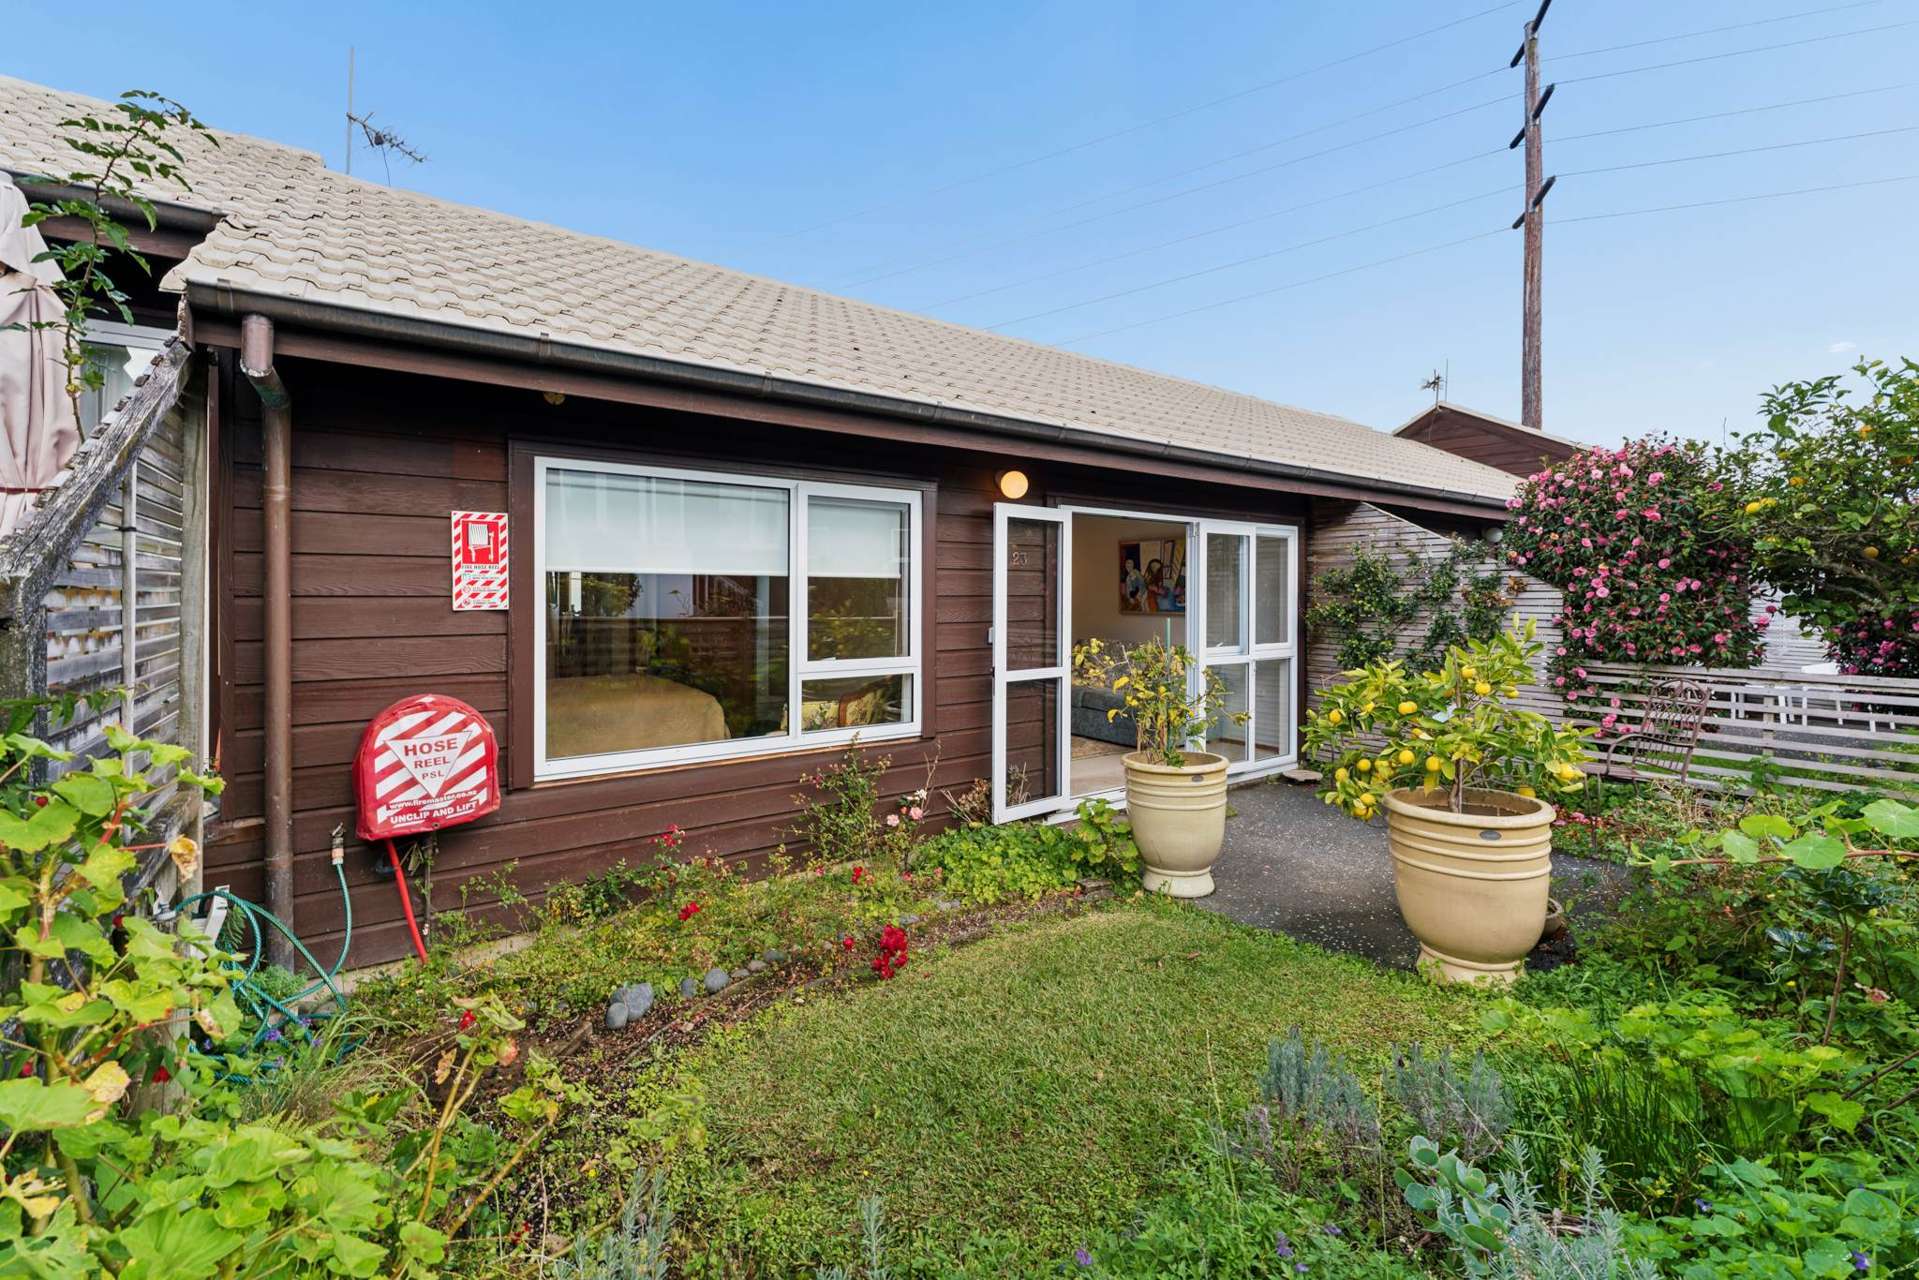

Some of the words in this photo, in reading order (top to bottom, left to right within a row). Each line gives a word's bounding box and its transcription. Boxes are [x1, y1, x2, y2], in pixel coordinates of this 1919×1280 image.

[1012, 551, 1028, 566] 23
[404, 738, 457, 756] HOSE
[414, 756, 450, 769] REEL
[422, 770, 444, 780] PSL
[390, 811, 430, 824] UNCLIP
[432, 807, 454, 817] AND
[456, 801, 477, 813] LIFT
